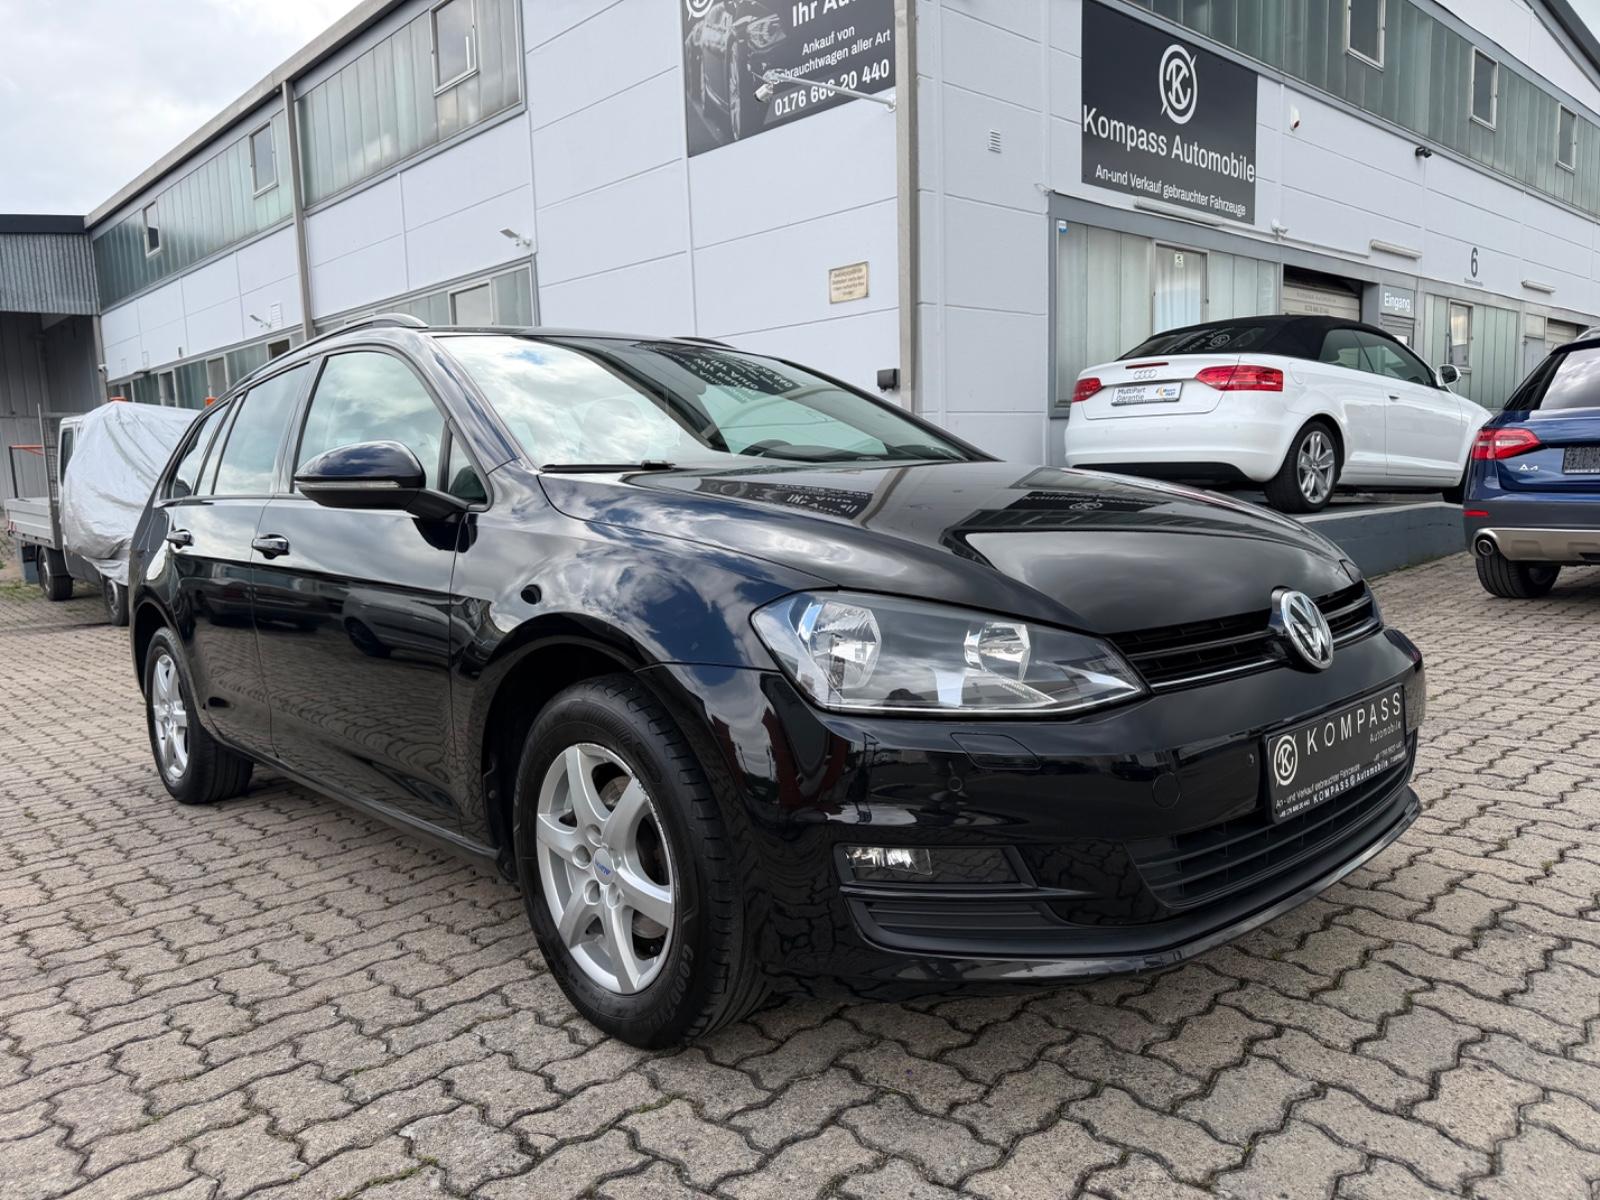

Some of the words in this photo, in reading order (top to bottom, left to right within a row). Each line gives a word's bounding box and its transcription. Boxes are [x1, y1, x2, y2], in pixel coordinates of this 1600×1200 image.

[792, 1, 818, 27] Ihr
[802, 31, 835, 56] Ankauf
[837, 26, 855, 41] von
[851, 38, 873, 55] aller
[875, 29, 890, 46] Art
[774, 90, 806, 116] 0176
[840, 70, 858, 90] 20
[862, 59, 889, 83] 440
[1083, 104, 1168, 156] Kompass
[1171, 135, 1255, 183] Automobile
[1095, 164, 1128, 186] An-und
[1129, 173, 1162, 194] Verkauf
[1163, 184, 1209, 206] gebrauchter
[1209, 195, 1247, 218] Fahrzeuge
[1470, 247, 1479, 278] 6
[1384, 292, 1411, 312] Eingang
[1306, 692, 1401, 755] KOMPASS
[1313, 778, 1350, 804] KOMPASS
